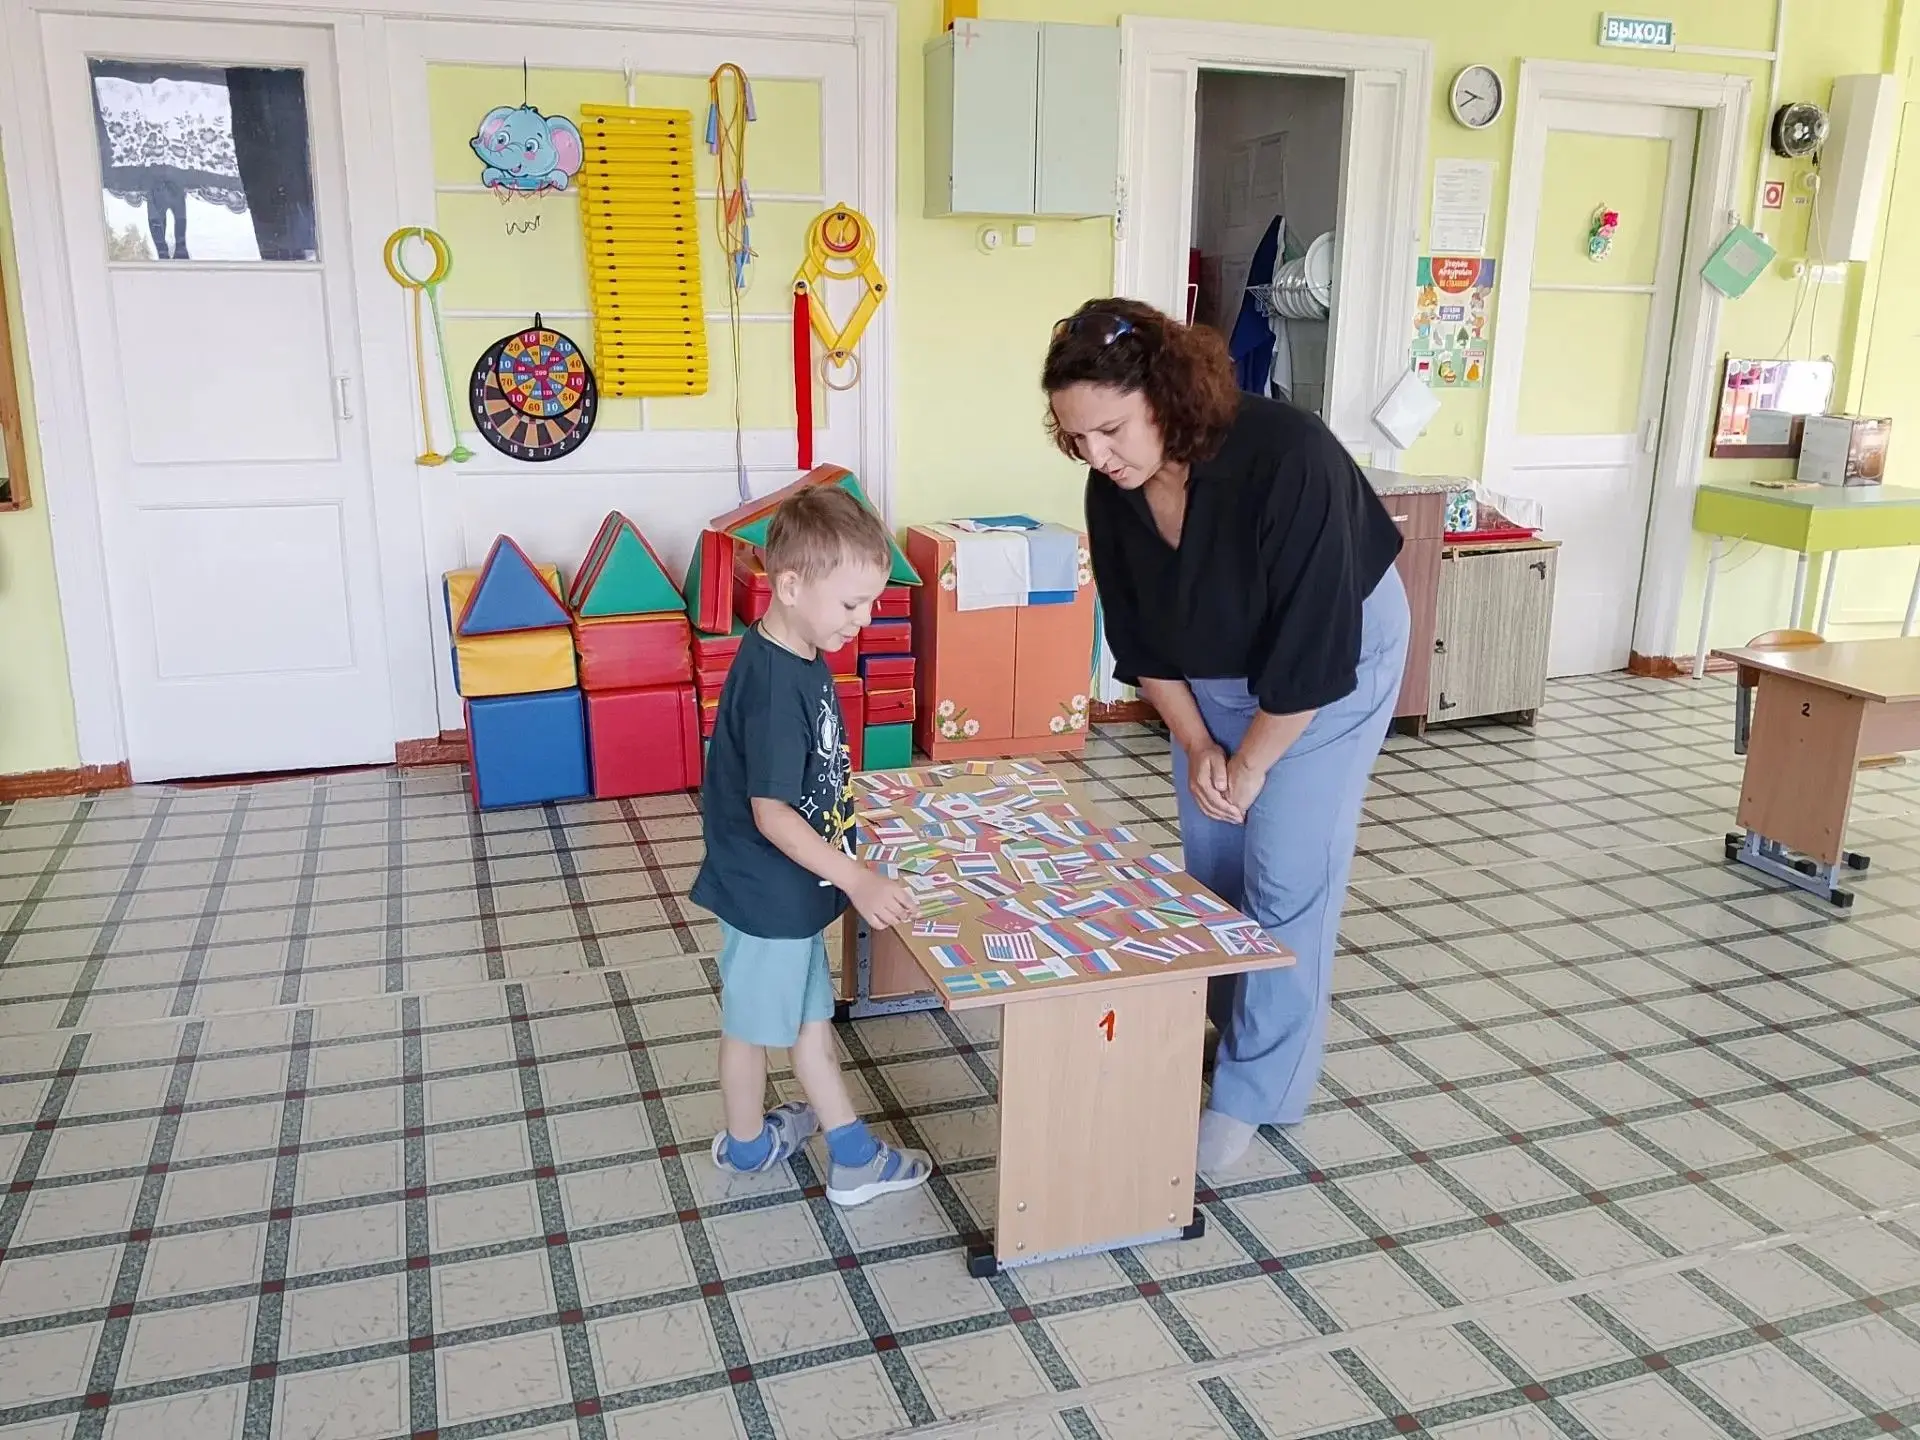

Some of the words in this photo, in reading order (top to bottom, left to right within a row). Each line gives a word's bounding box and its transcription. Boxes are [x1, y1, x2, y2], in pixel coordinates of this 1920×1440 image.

[1608, 20, 1667, 44] ВЫХОД
[524, 334, 536, 342] 10
[569, 360, 581, 368] 40
[1801, 702, 1811, 718] 2
[1099, 1009, 1115, 1042] 1
